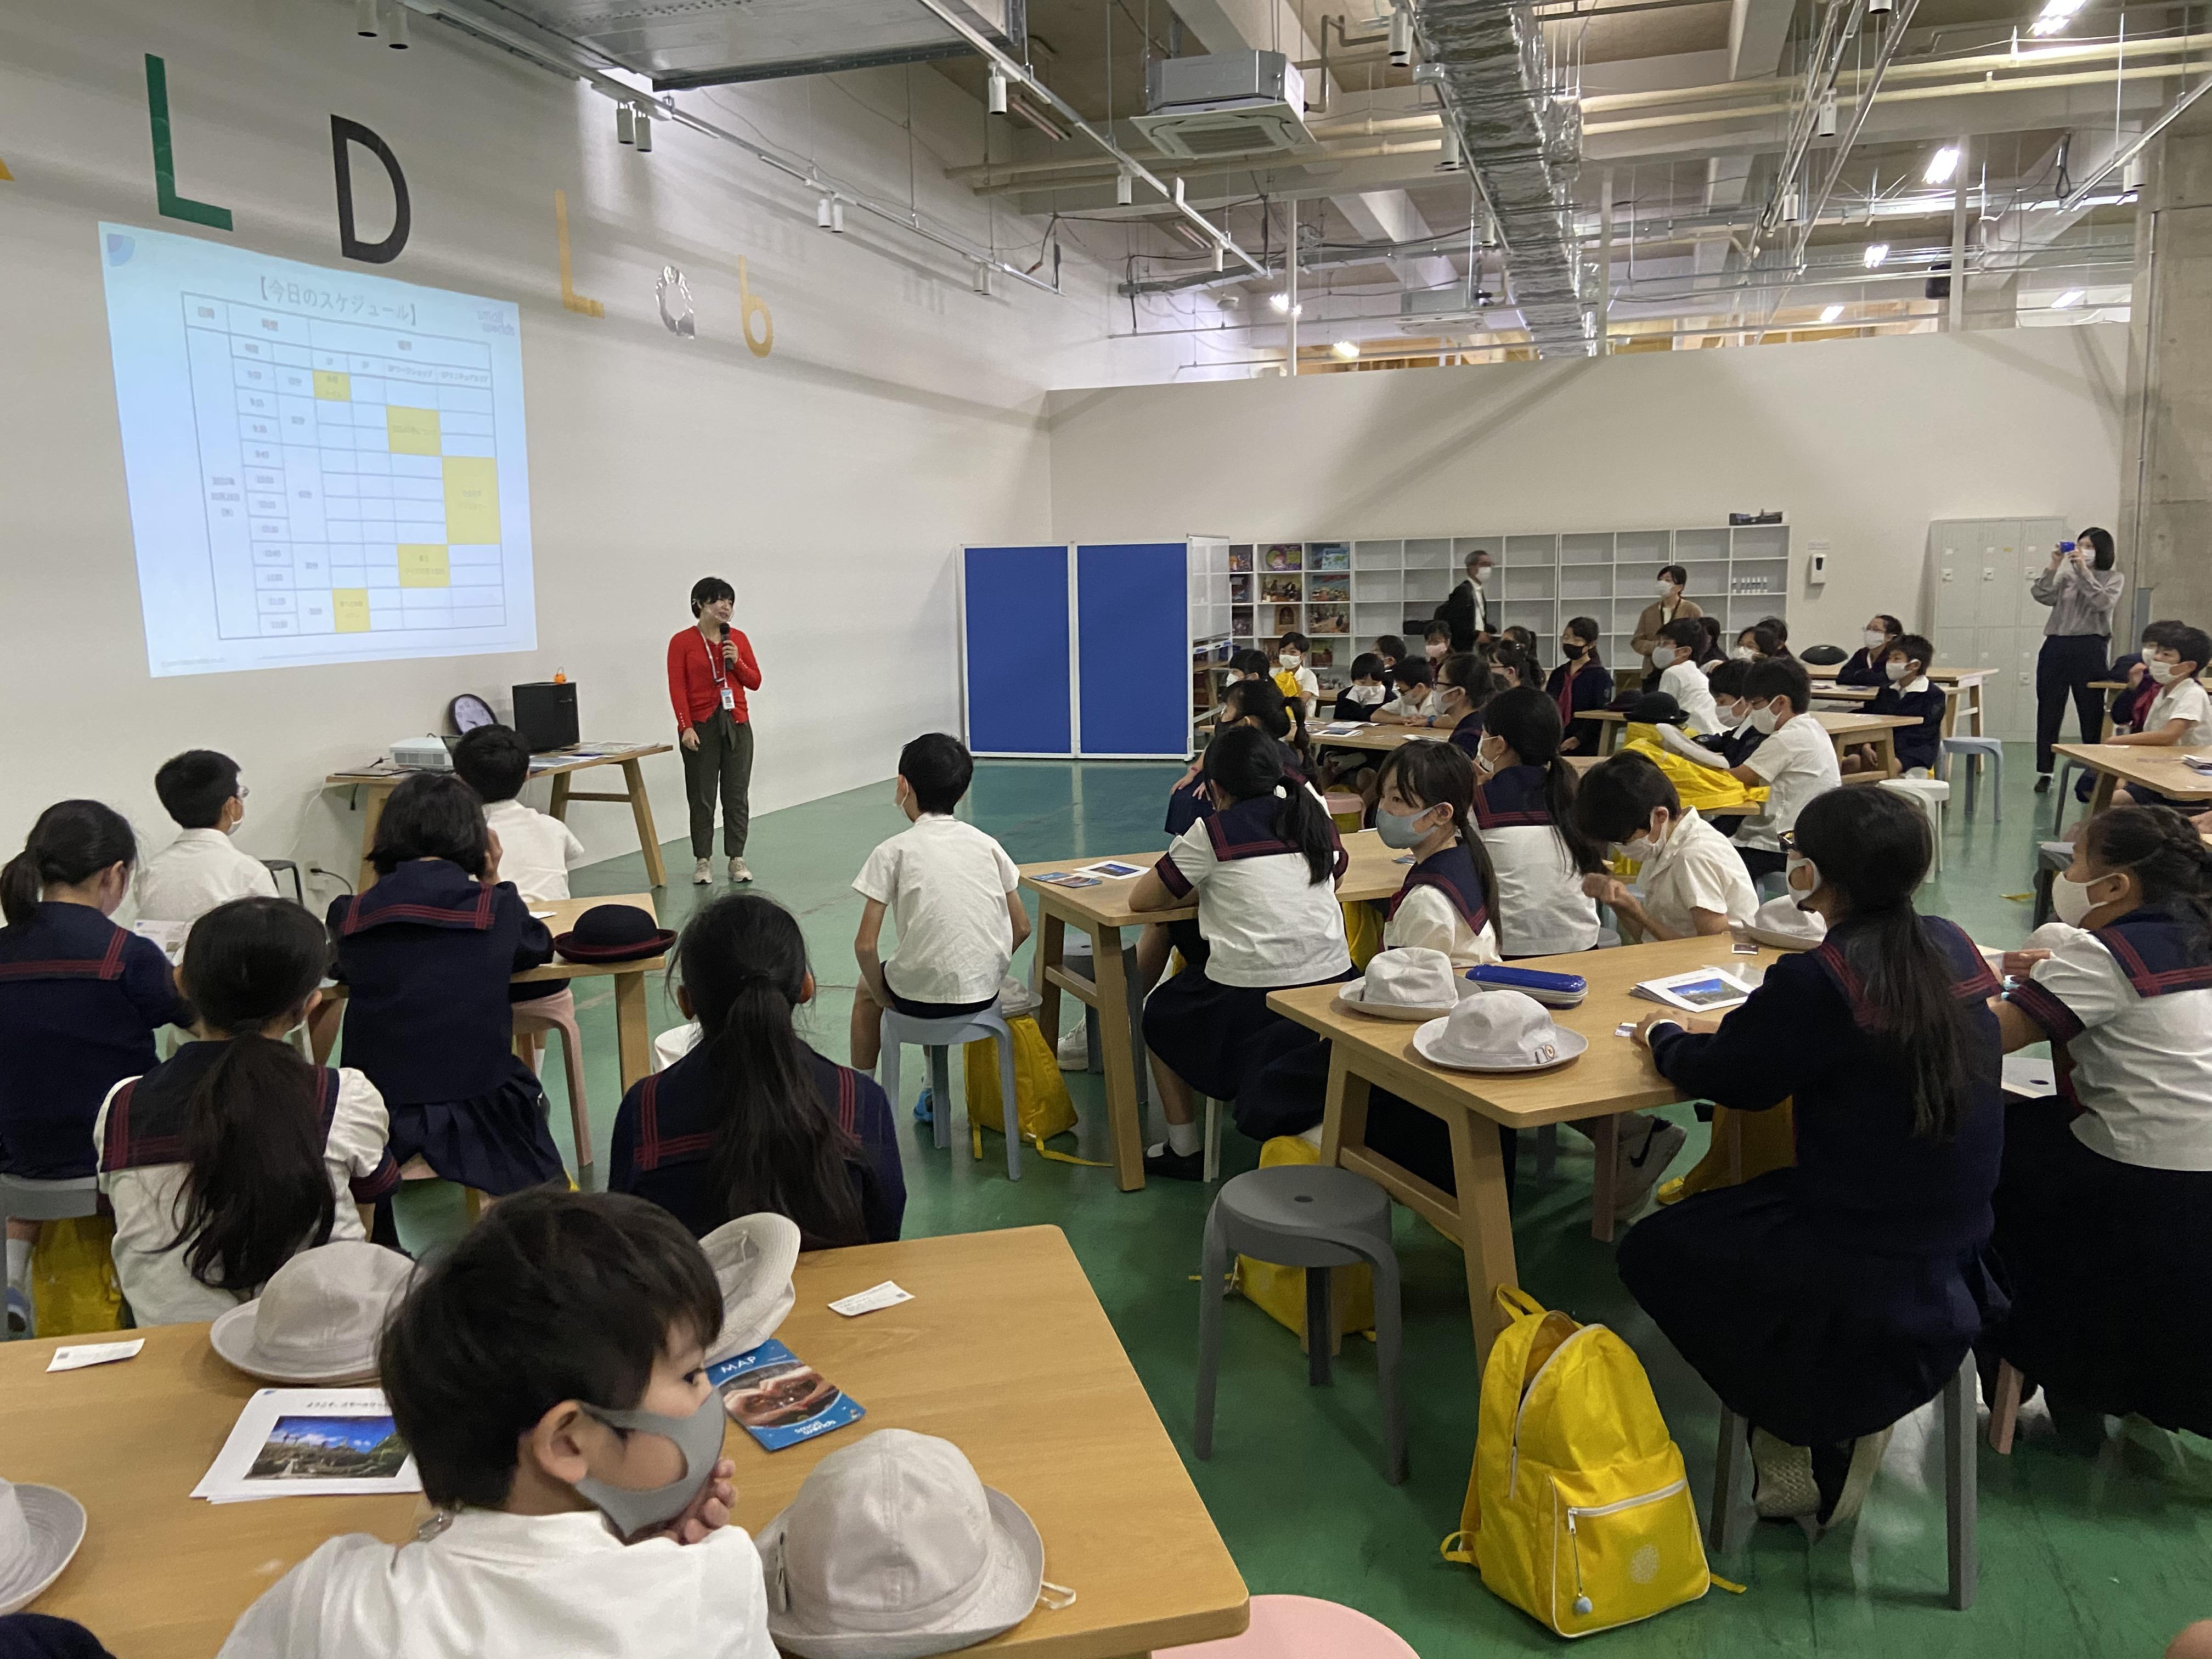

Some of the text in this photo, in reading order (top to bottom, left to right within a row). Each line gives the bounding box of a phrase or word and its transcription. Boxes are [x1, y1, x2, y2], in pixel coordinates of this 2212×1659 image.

[260, 275, 416, 326] 【今日のスケジュール】
[721, 1356, 756, 1373] MAP
